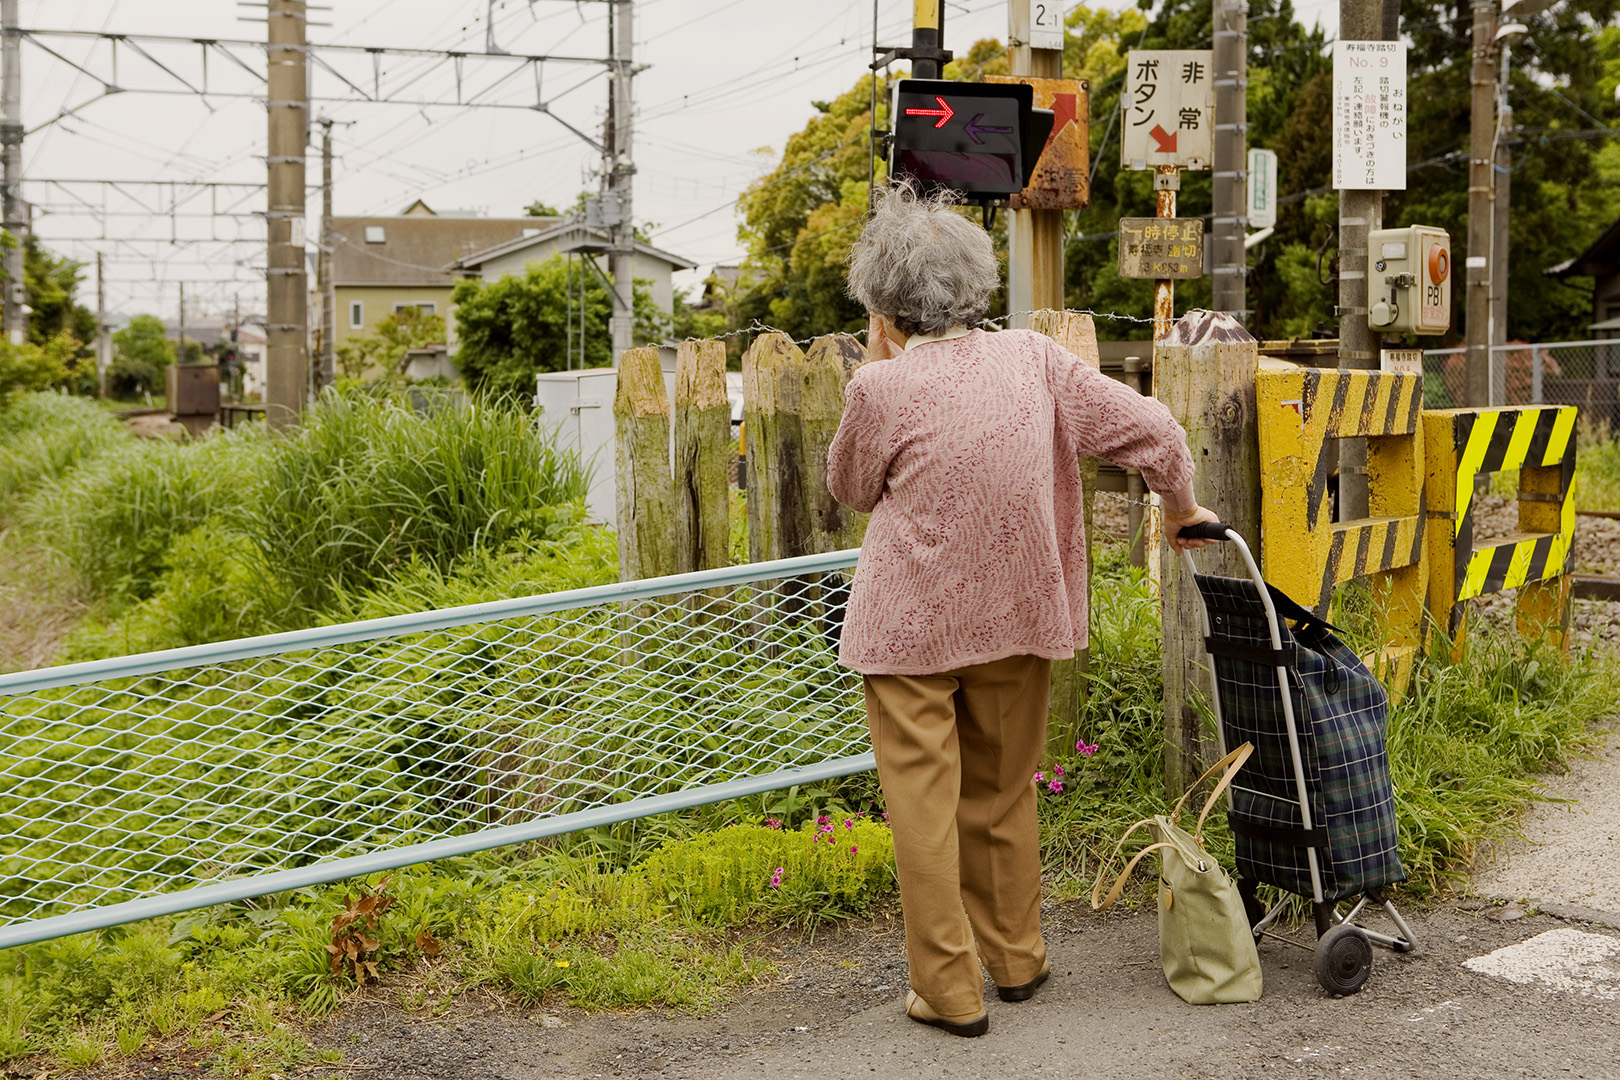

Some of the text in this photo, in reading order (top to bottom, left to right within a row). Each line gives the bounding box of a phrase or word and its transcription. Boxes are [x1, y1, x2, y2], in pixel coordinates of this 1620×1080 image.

[1346, 43, 1397, 53] 寿福寺踏切
[1349, 56, 1389, 68] No. 9
[1132, 59, 1160, 127] ボタン
[1178, 61, 1205, 130] 非常
[1379, 76, 1390, 129] 踏切警報機の
[1392, 88, 1404, 140] おねがい
[1127, 224, 1197, 241] 一時停止
